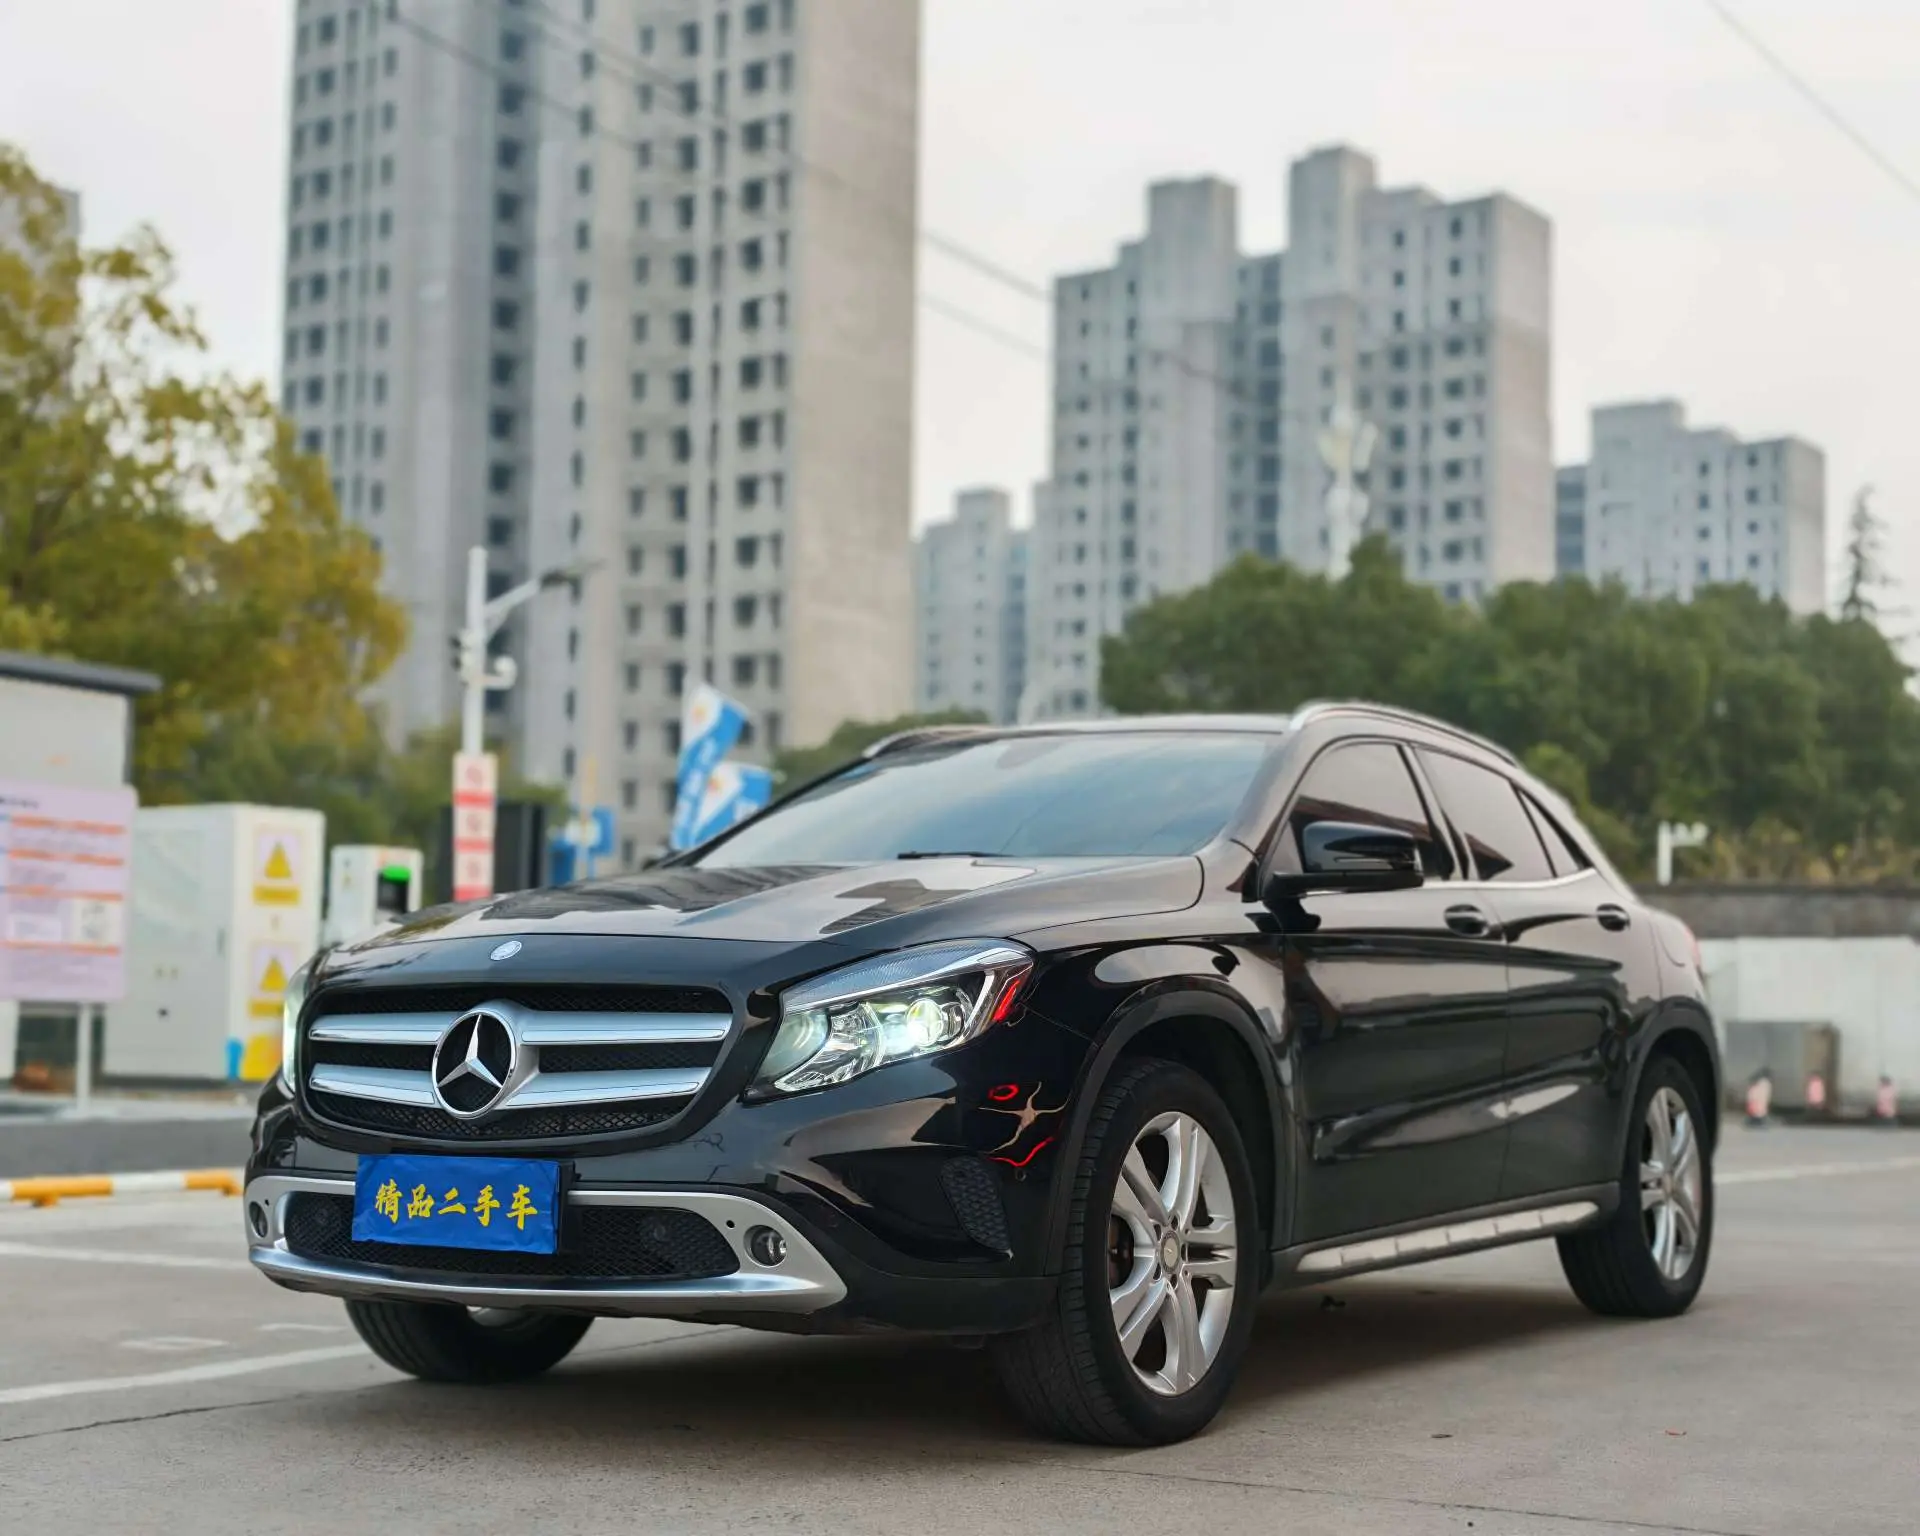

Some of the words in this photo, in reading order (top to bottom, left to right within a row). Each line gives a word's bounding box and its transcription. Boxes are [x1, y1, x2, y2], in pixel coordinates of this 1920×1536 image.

[375, 1179, 538, 1230] 精品二手车
